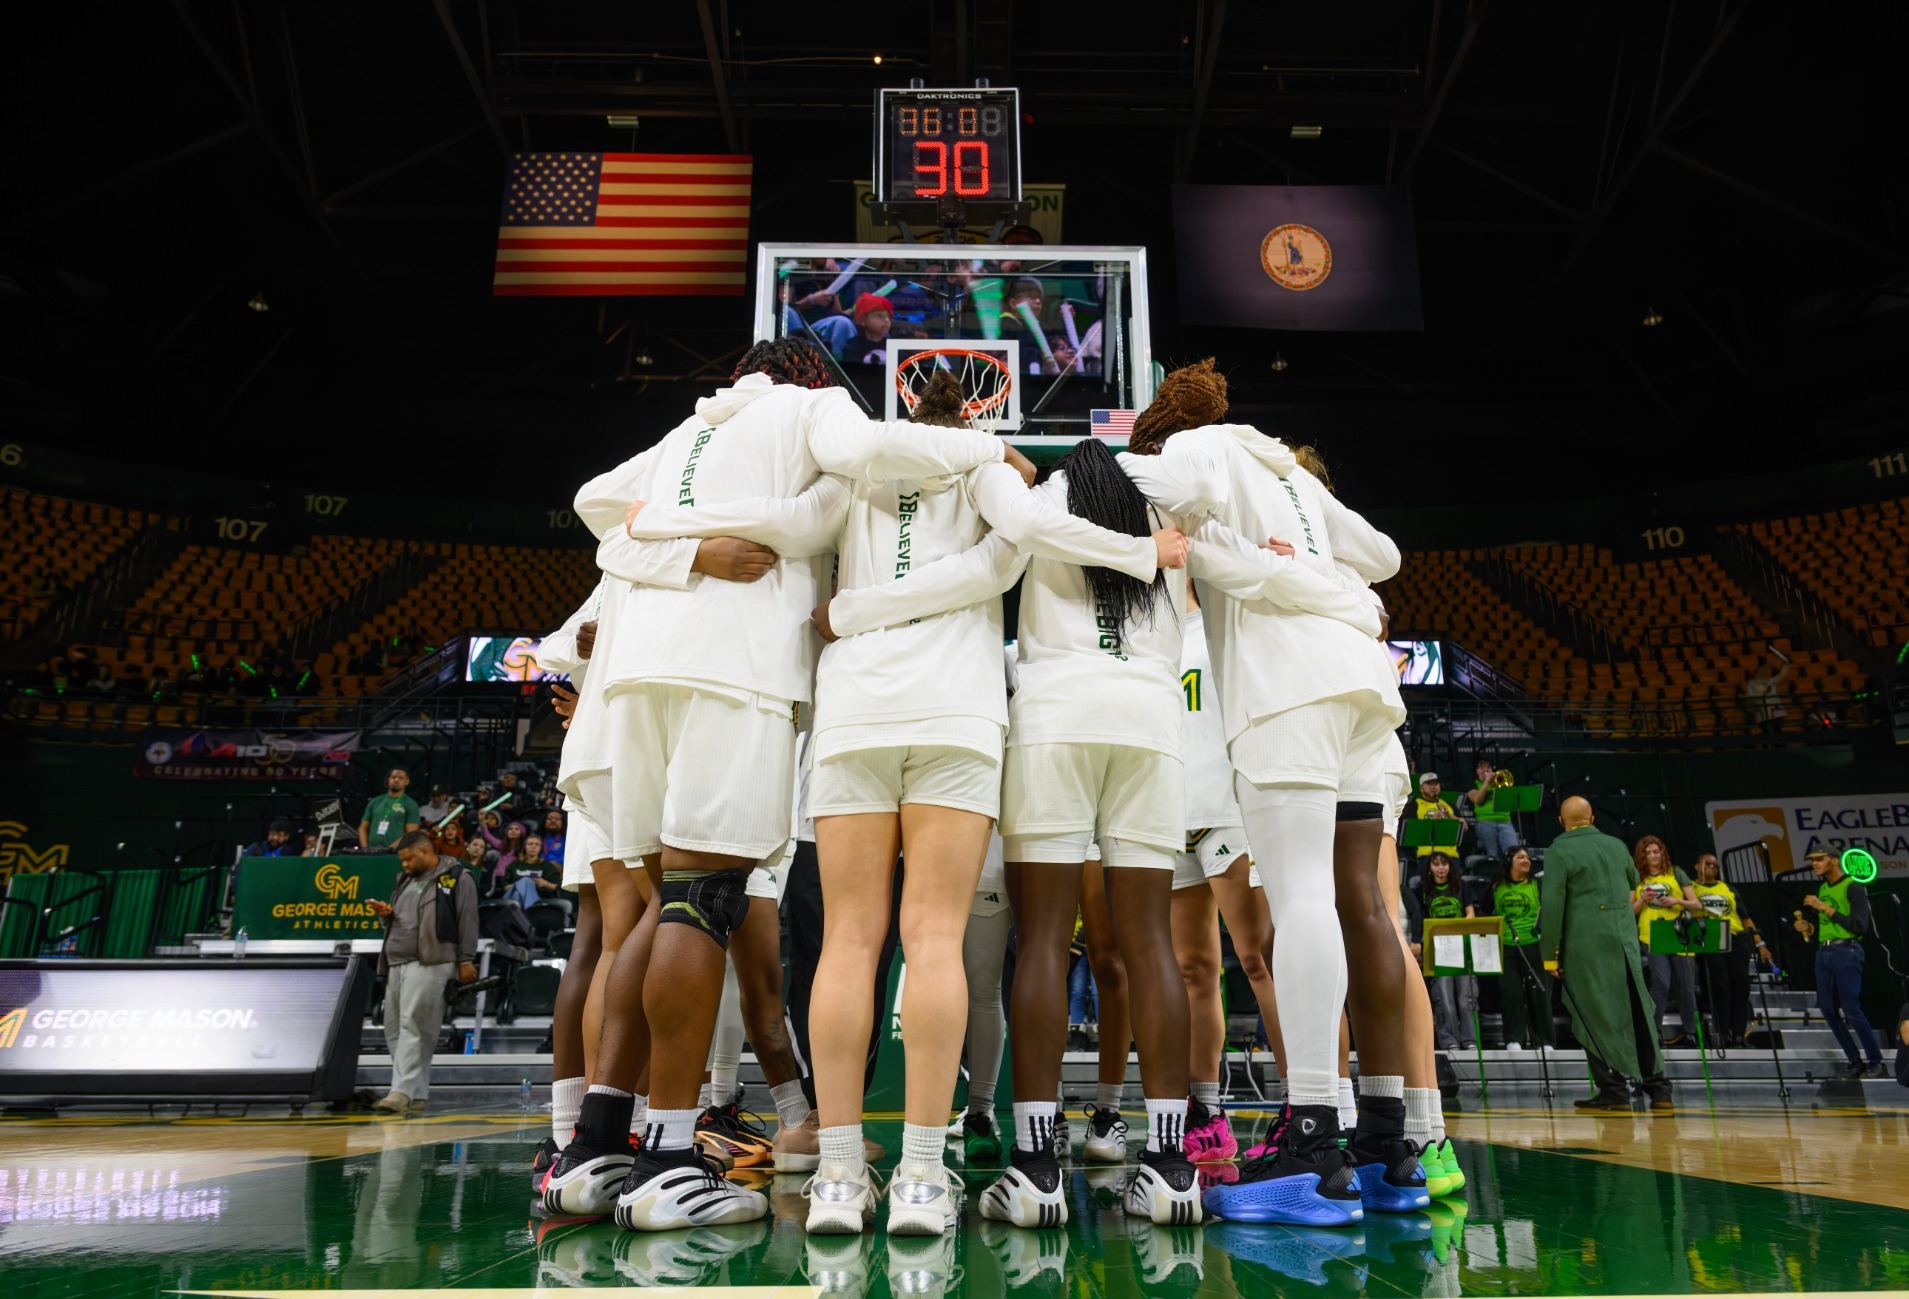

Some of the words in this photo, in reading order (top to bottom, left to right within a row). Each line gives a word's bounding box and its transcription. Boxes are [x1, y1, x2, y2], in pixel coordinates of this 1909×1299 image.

[914, 141, 990, 196] 30
[1867, 452, 1909, 479] 111
[304, 494, 348, 516] 107
[214, 516, 268, 543] 107
[1641, 525, 1685, 551] 110
[315, 863, 360, 900] GM
[272, 903, 337, 918] GEORGE
[340, 903, 378, 917] MAS
[293, 920, 380, 929] ATHLETICS
[32, 1009, 146, 1030] GEORGE
[22, 1035, 203, 1048] BASKETBALL
